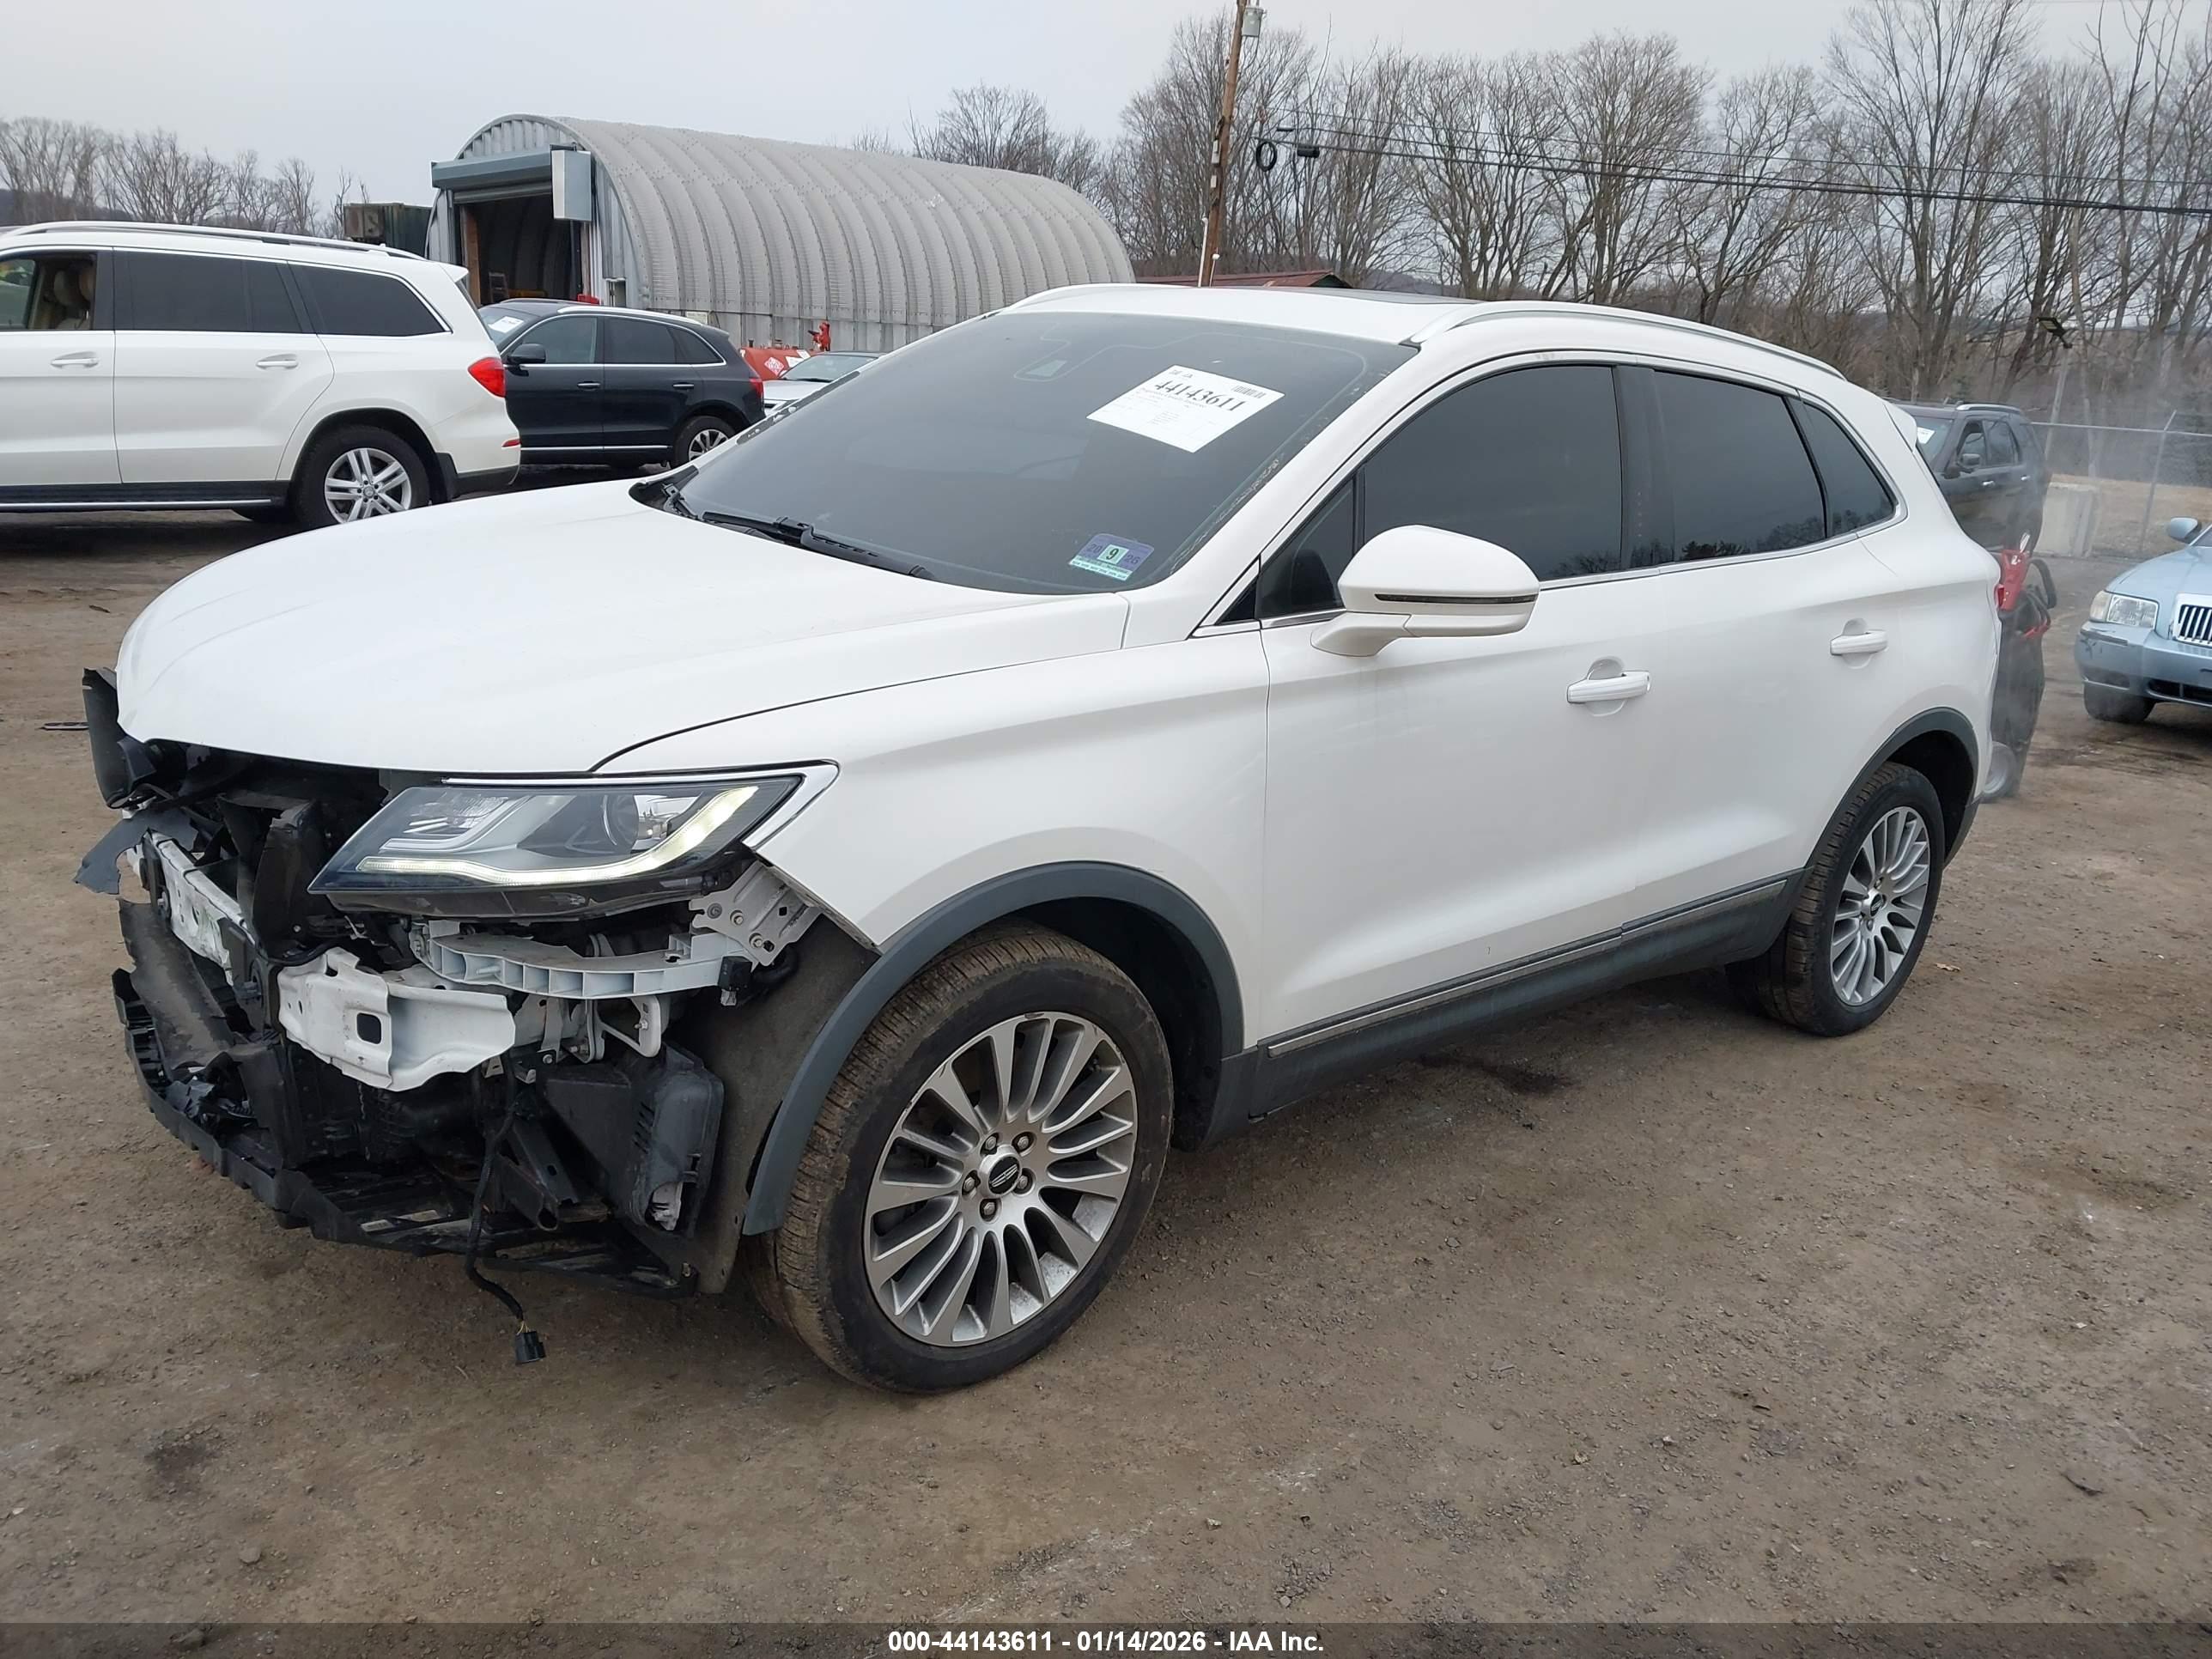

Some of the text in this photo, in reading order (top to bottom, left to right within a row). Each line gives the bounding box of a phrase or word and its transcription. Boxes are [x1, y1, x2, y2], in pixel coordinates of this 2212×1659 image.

[1154, 380, 1247, 411] 44143611
[1085, 543, 1103, 554] 20
[1105, 548, 1120, 561] 9
